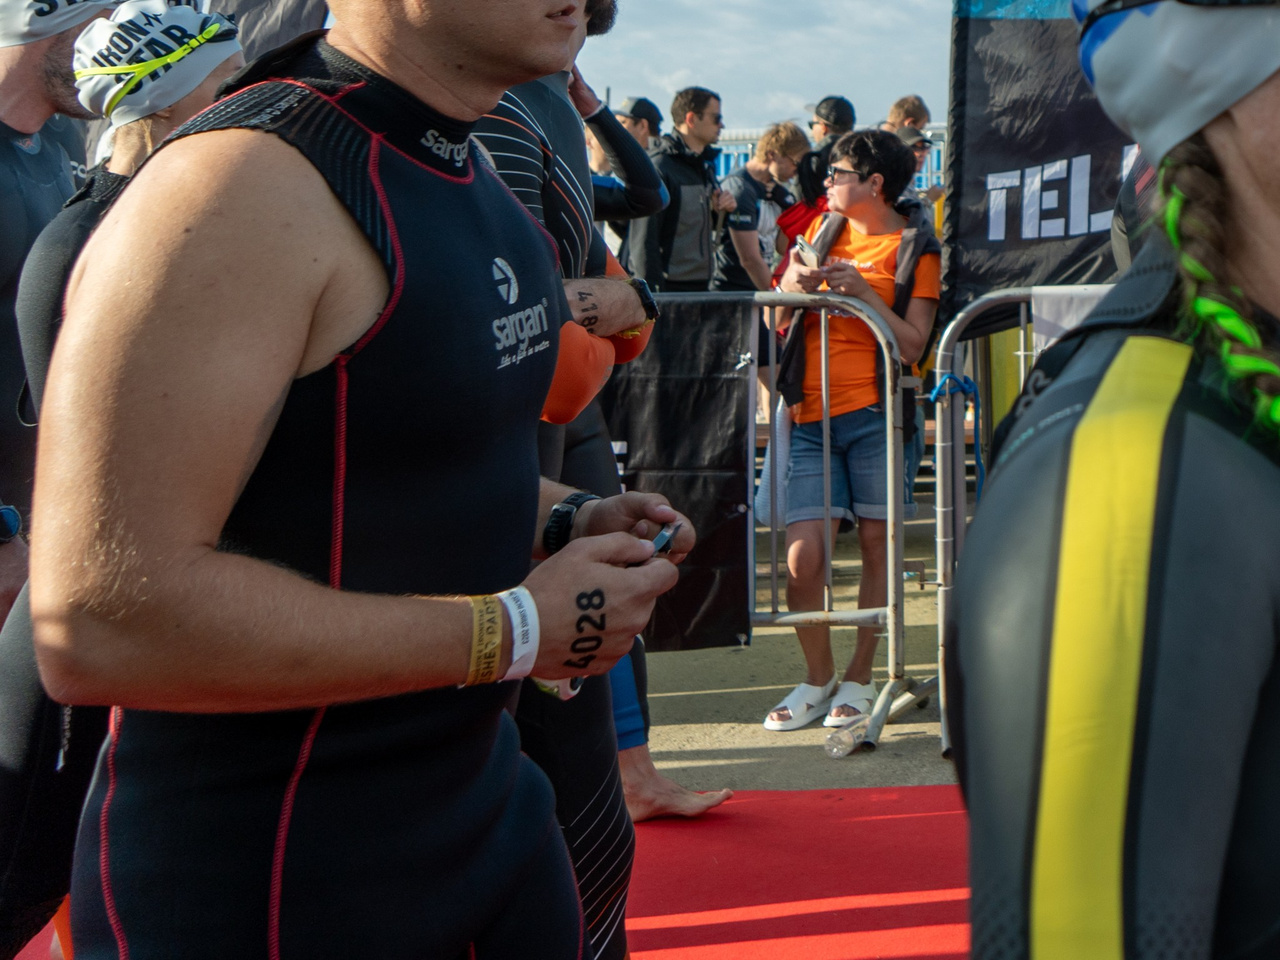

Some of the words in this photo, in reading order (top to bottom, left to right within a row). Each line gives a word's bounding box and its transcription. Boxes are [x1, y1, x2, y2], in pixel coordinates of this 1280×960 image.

[91, 18, 149, 69] IRON
[492, 302, 549, 351] sargan
[563, 588, 606, 669] 4028
